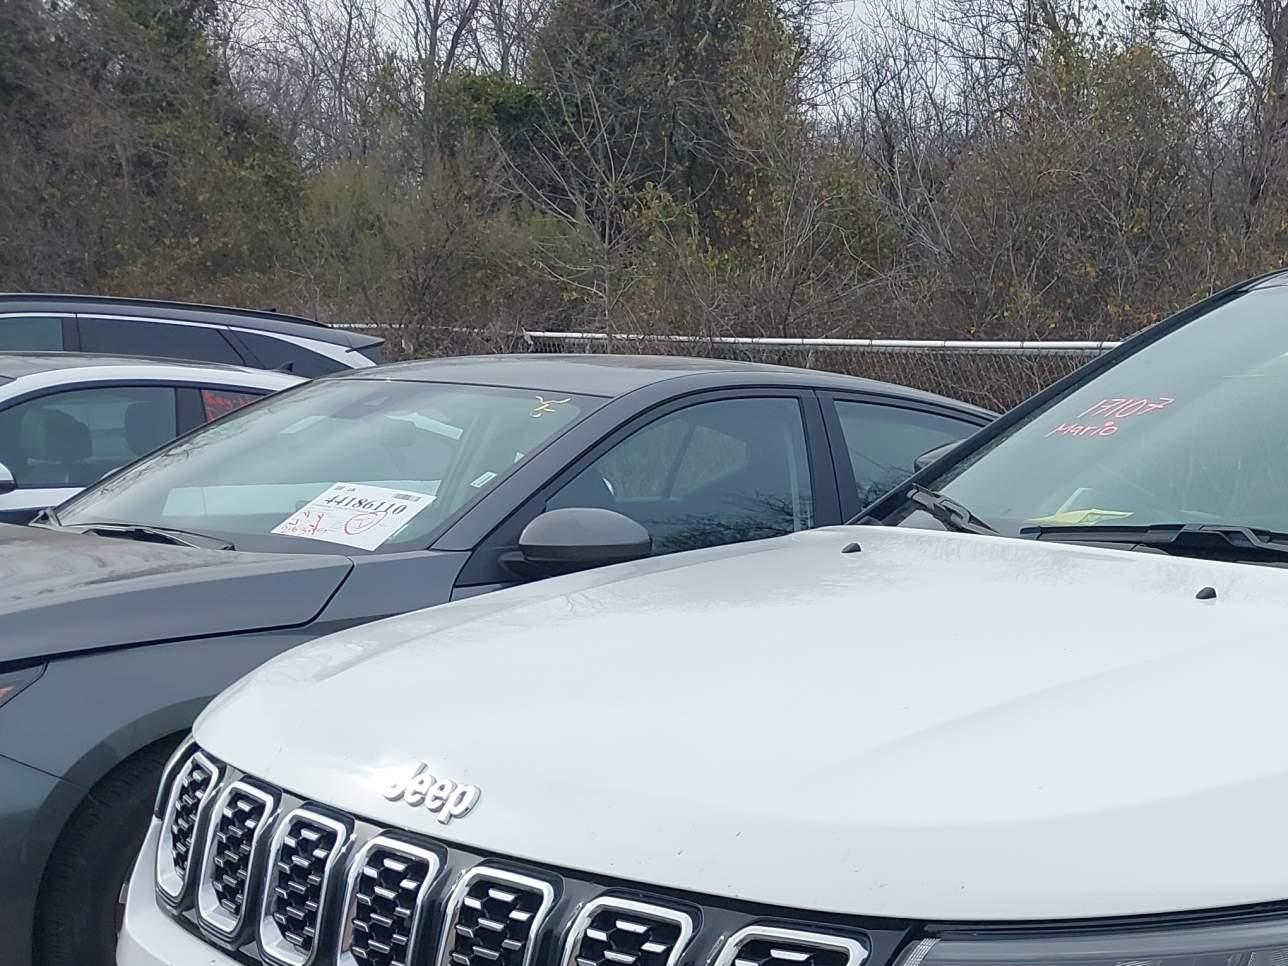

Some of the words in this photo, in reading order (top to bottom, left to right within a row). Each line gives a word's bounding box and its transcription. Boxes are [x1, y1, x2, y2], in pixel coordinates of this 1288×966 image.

[1045, 421, 1119, 437] Mario
[324, 494, 408, 515] 44186110
[383, 760, 483, 826] Jeep
